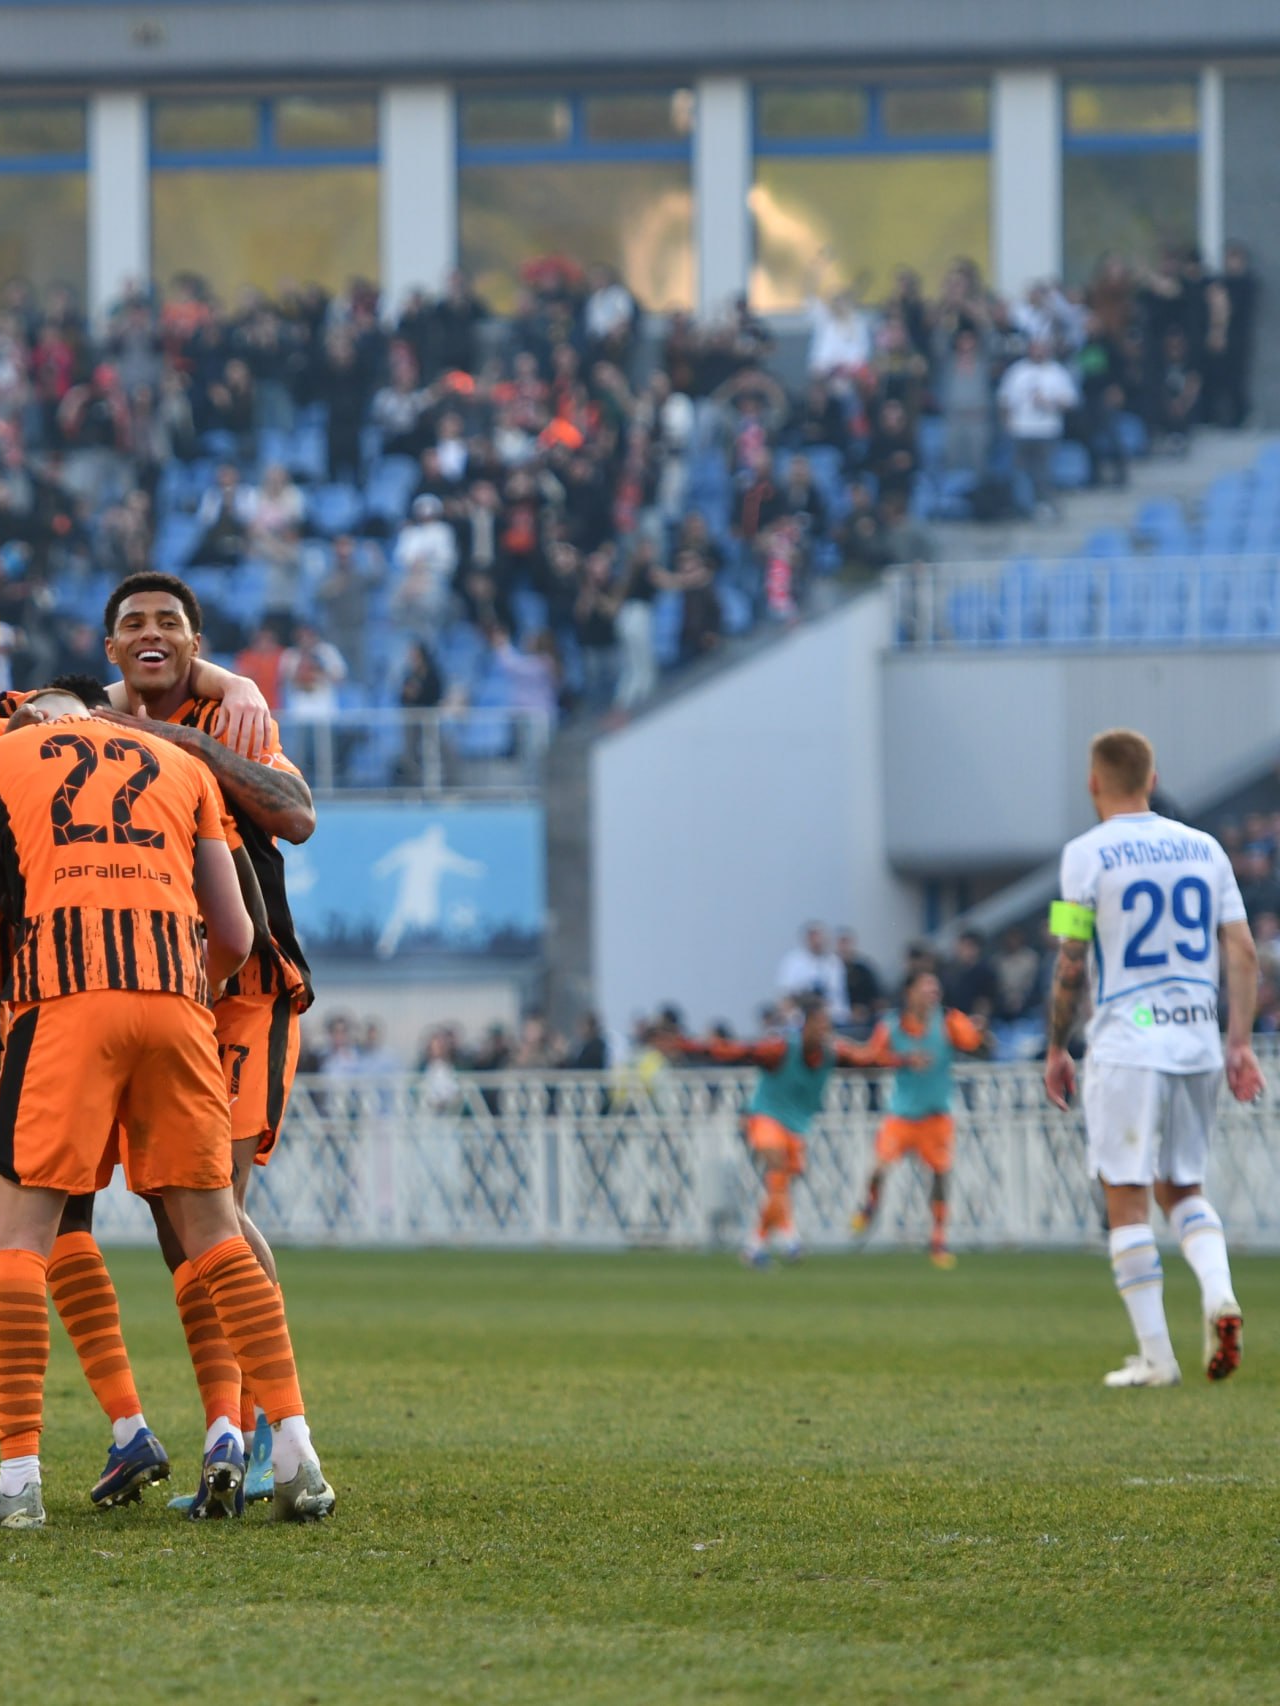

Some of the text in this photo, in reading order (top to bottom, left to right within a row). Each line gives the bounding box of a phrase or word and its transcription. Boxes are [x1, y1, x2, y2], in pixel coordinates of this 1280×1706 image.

[40, 734, 166, 850] 22
[54, 863, 172, 885] parallel.ua
[1121, 875, 1212, 969] 29
